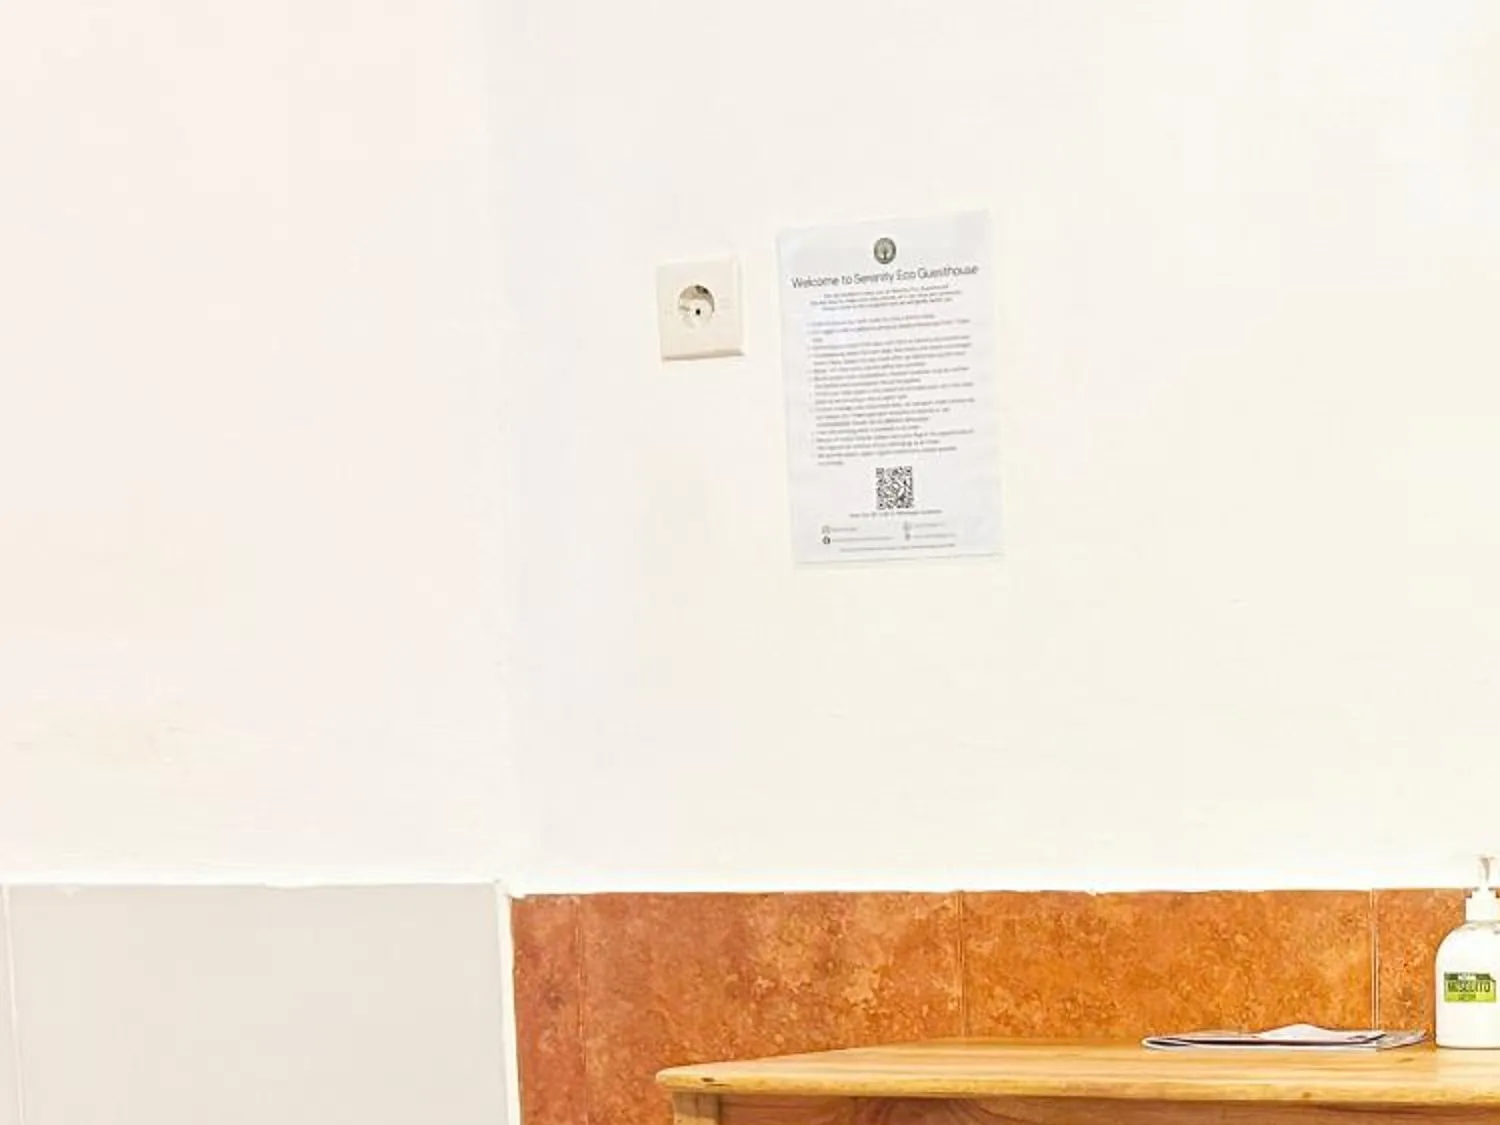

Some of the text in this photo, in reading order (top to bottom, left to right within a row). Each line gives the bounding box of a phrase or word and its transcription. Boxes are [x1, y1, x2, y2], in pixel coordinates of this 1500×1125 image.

[791, 264, 979, 289] Welcome to Serenity Eco Guesthouse
